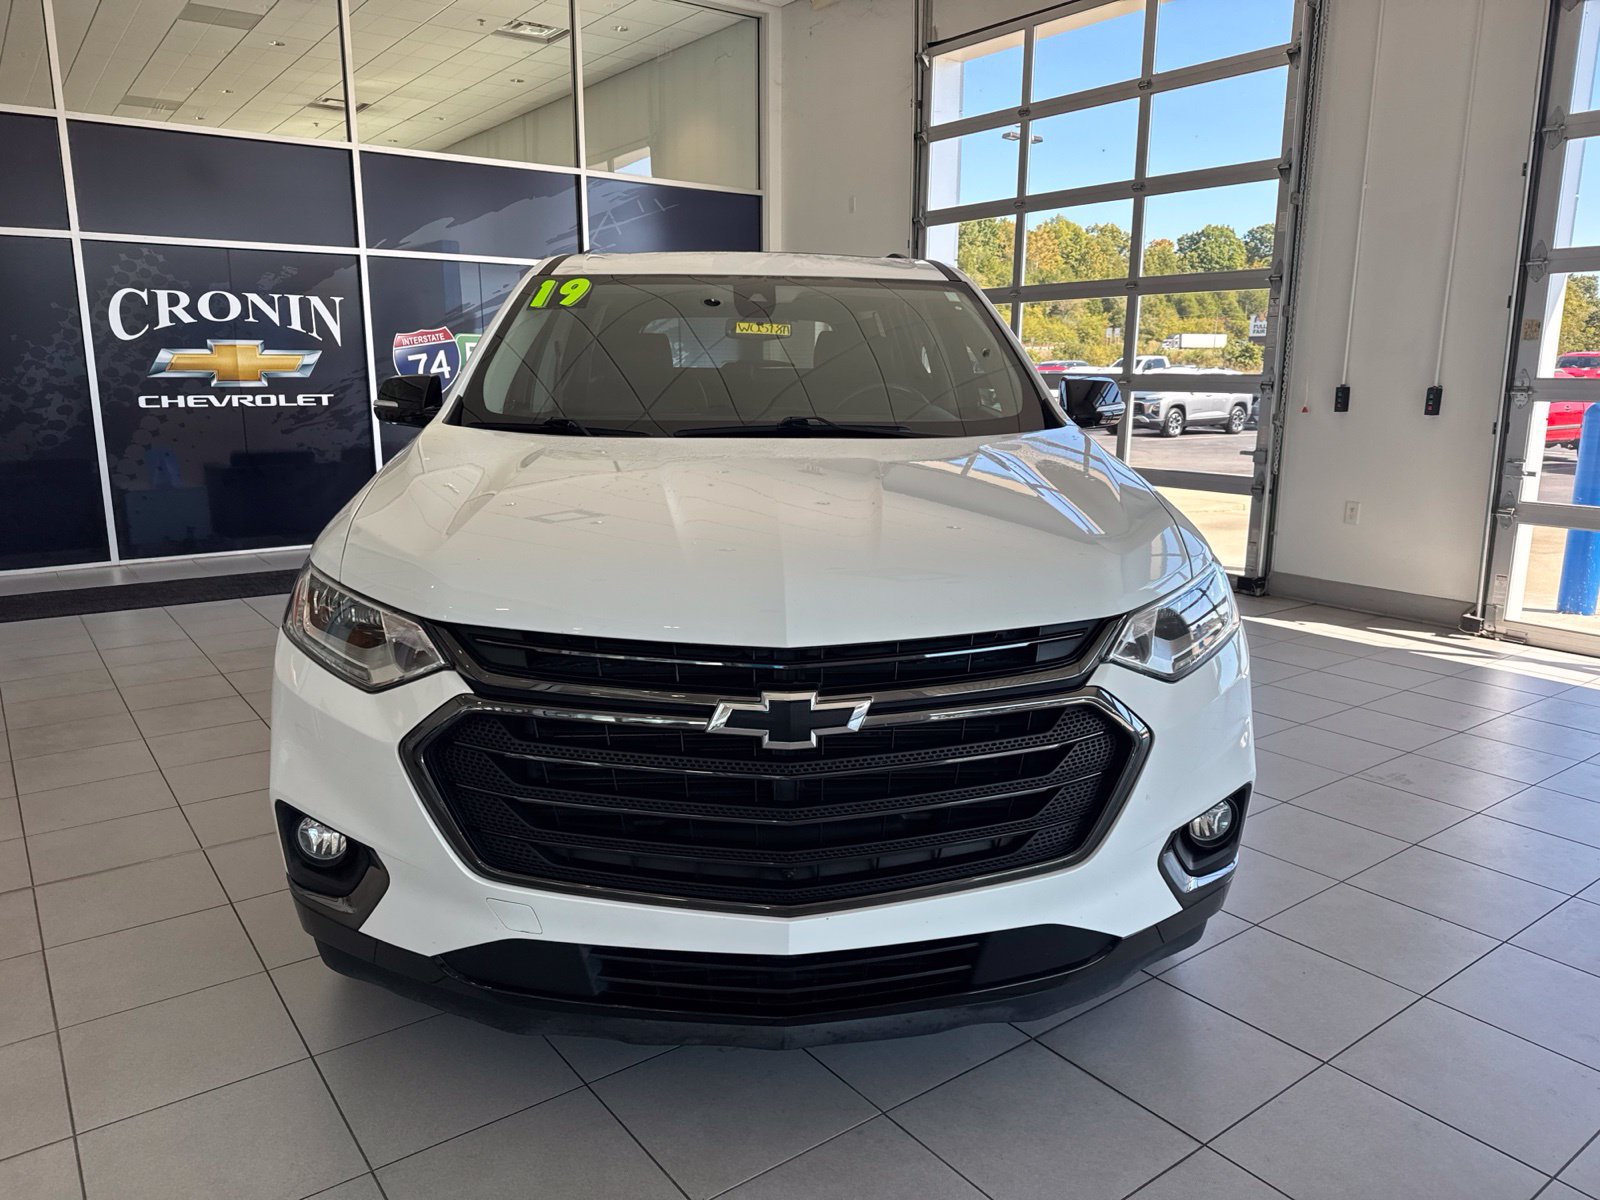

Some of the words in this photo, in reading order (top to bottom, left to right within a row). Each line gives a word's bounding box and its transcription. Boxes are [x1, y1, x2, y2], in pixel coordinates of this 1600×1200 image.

[530, 278, 592, 308] 19
[108, 287, 345, 347] CRONIN
[401, 332, 446, 346] INTERSTATE
[407, 349, 452, 379] 74
[137, 393, 334, 409] CHEVROLET
